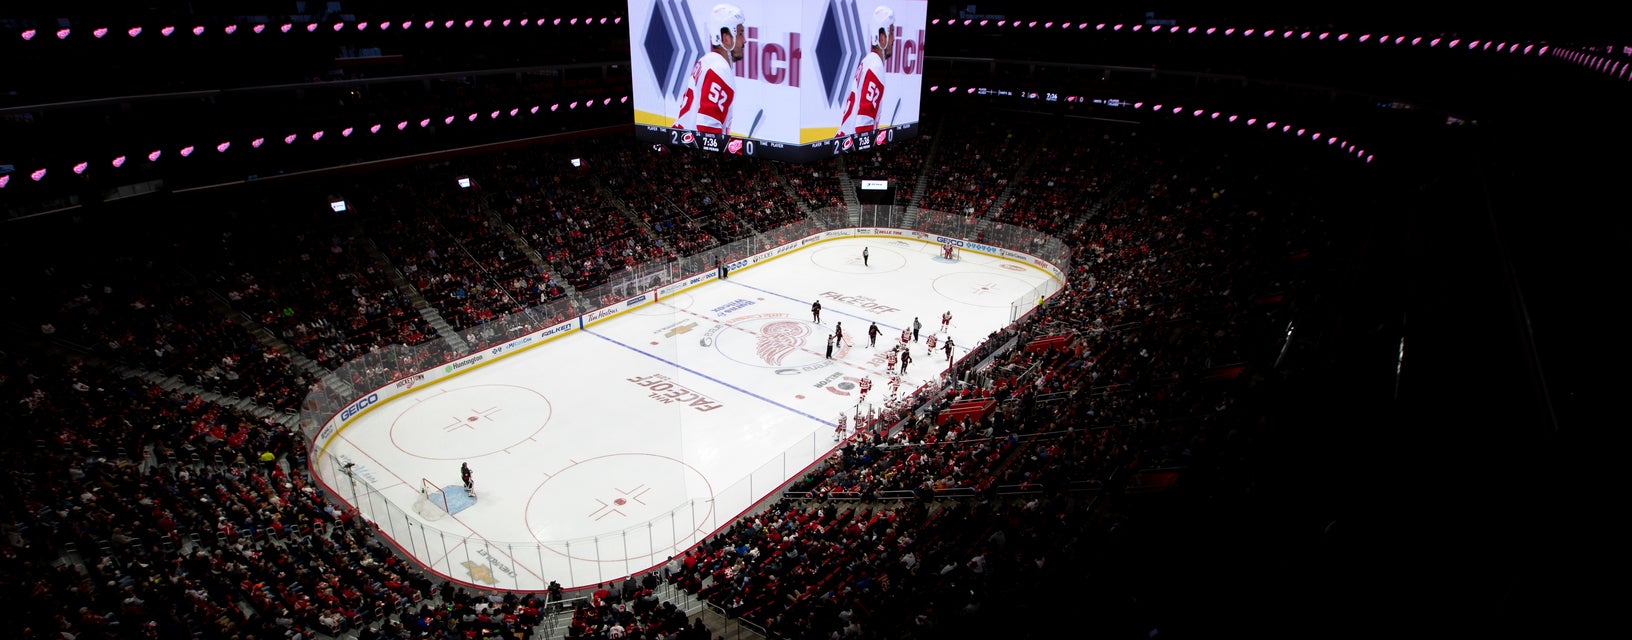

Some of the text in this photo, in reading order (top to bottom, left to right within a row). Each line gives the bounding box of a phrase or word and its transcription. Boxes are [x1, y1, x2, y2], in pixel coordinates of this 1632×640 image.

[708, 81, 728, 112] 52
[866, 81, 880, 109] 52
[671, 130, 679, 145] 2
[702, 137, 718, 147] 7:36
[859, 136, 870, 146] 7:36
[888, 129, 893, 142] 0
[746, 140, 754, 156] 0
[833, 140, 840, 155] 2
[588, 308, 618, 323] Tim Hortons
[452, 354, 484, 370] Huntington
[395, 374, 425, 389] HOCKEYTOWN
[647, 391, 674, 405] NHL
[340, 393, 379, 422] GEICO
[475, 548, 518, 578] CHEVROLET
